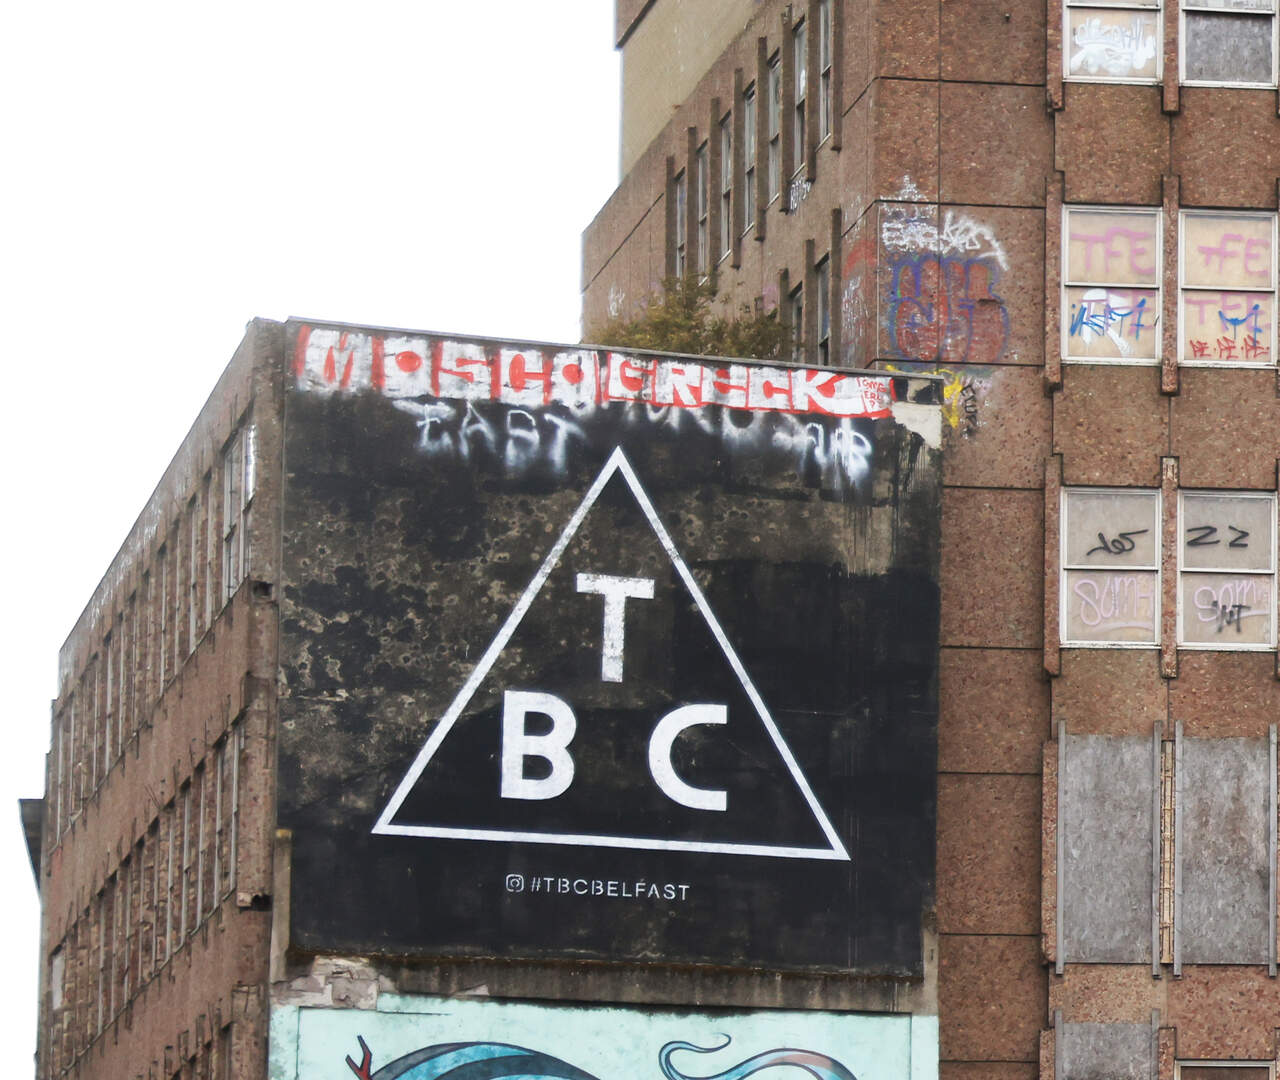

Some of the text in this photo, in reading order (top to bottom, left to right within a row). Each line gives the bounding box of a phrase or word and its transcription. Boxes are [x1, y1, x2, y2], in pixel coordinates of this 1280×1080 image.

[576, 573, 655, 683] T
[501, 689, 728, 812] B C
[531, 876, 691, 901] #TBCBELFAST
